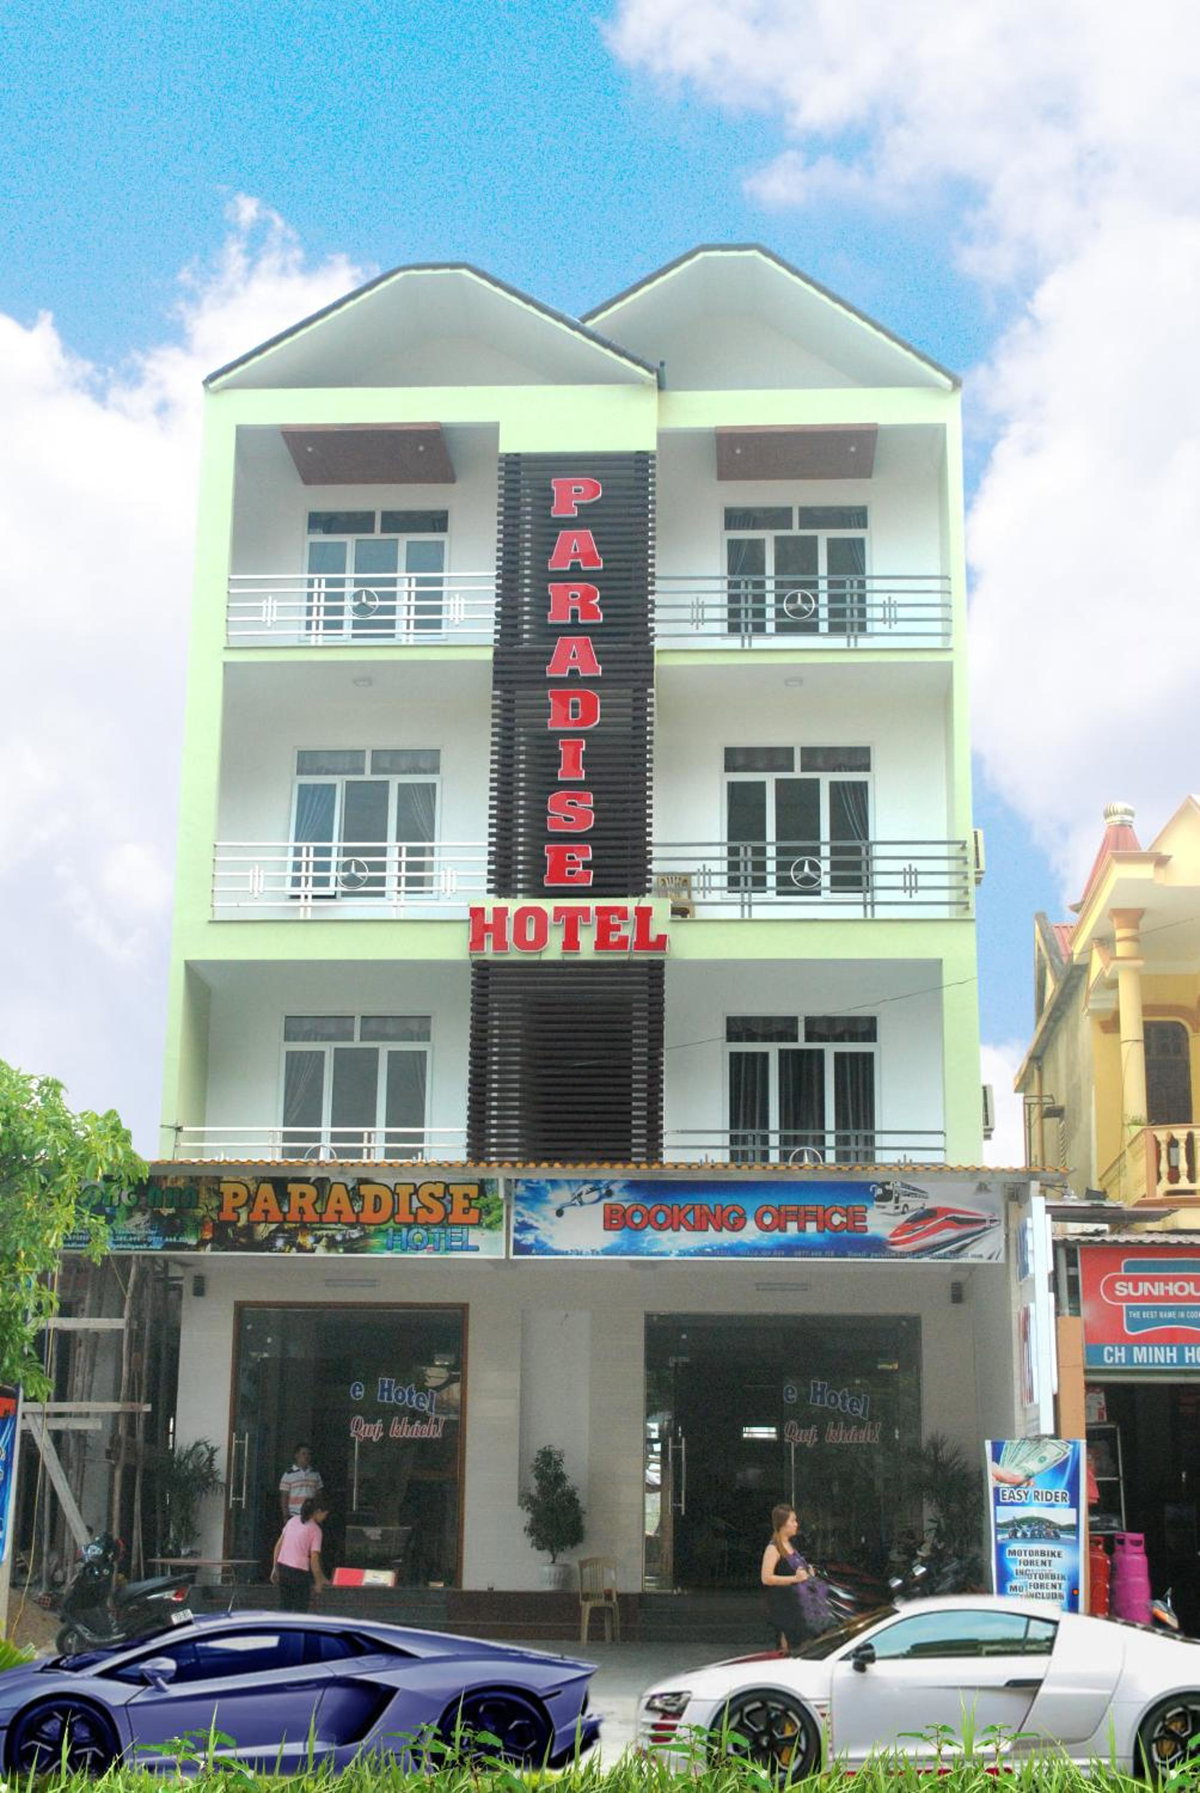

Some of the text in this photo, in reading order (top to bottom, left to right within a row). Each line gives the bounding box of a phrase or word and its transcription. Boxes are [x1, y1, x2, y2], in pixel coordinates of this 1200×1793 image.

[544, 477, 603, 887] PARADISE
[468, 905, 668, 954] HOTEL
[217, 1180, 482, 1225] PARADISE
[603, 1203, 868, 1233] BOOKING OFFICE
[386, 1226, 480, 1252] HOTEL
[1129, 1310, 1140, 1318] THE
[1142, 1310, 1157, 1319] BEST
[1159, 1310, 1176, 1319] NAME
[1133, 1346, 1178, 1364] MINH
[377, 1377, 437, 1418] Hotel
[809, 1380, 870, 1421] Hotel
[1001, 1488, 1069, 1504] EASY RIDER
[1007, 1548, 1063, 1559] MOTORBIKE
